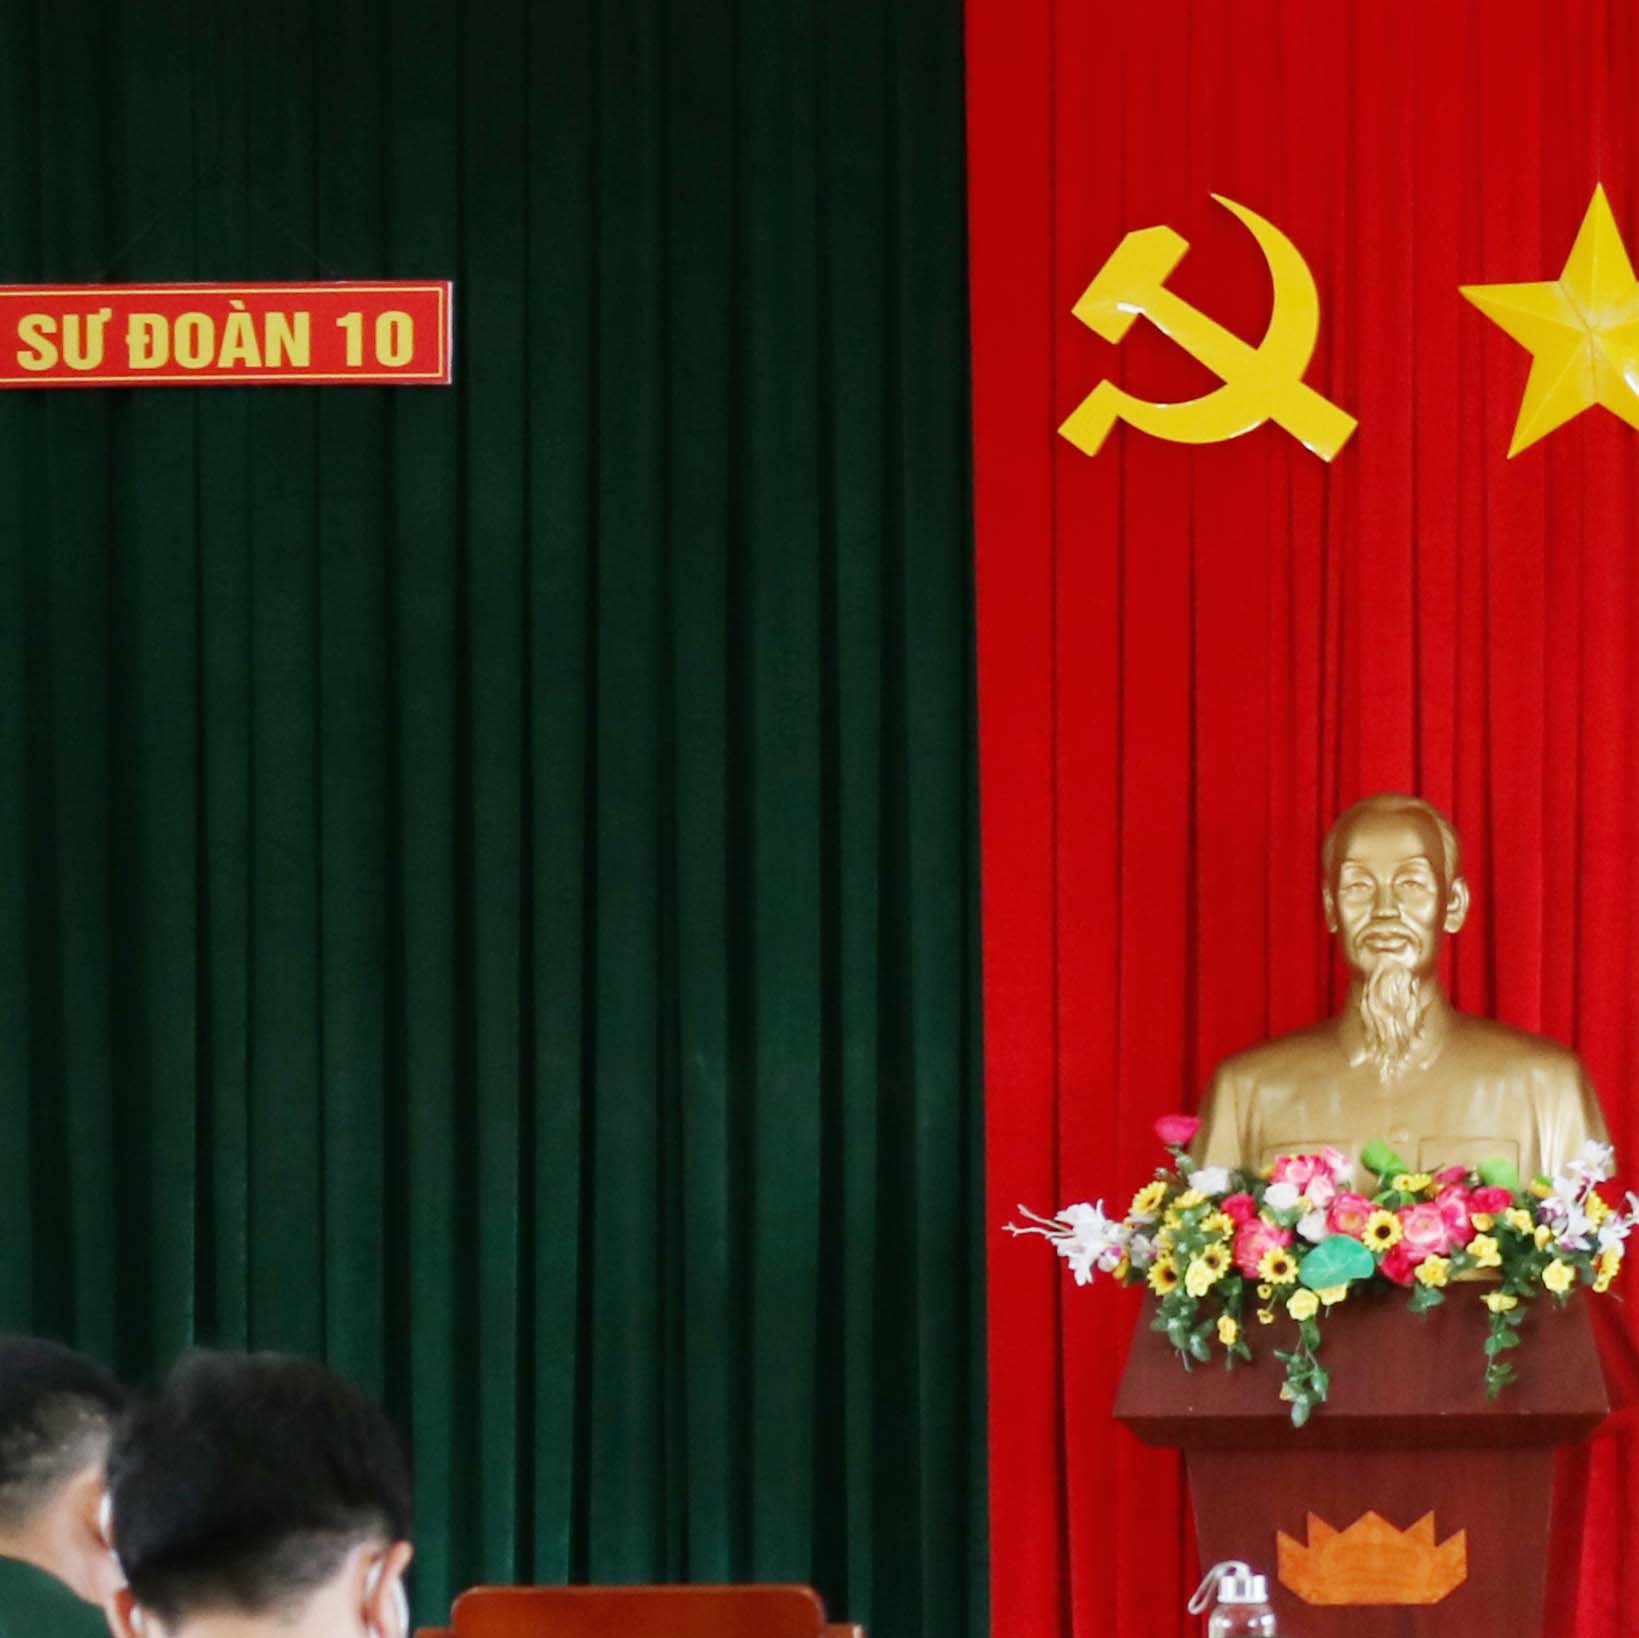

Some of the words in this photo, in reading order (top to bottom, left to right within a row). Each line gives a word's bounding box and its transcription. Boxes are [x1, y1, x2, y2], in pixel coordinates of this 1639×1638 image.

[16, 307, 113, 371] SƯ
[125, 299, 311, 369] ĐOÀN
[335, 311, 414, 368] 10
